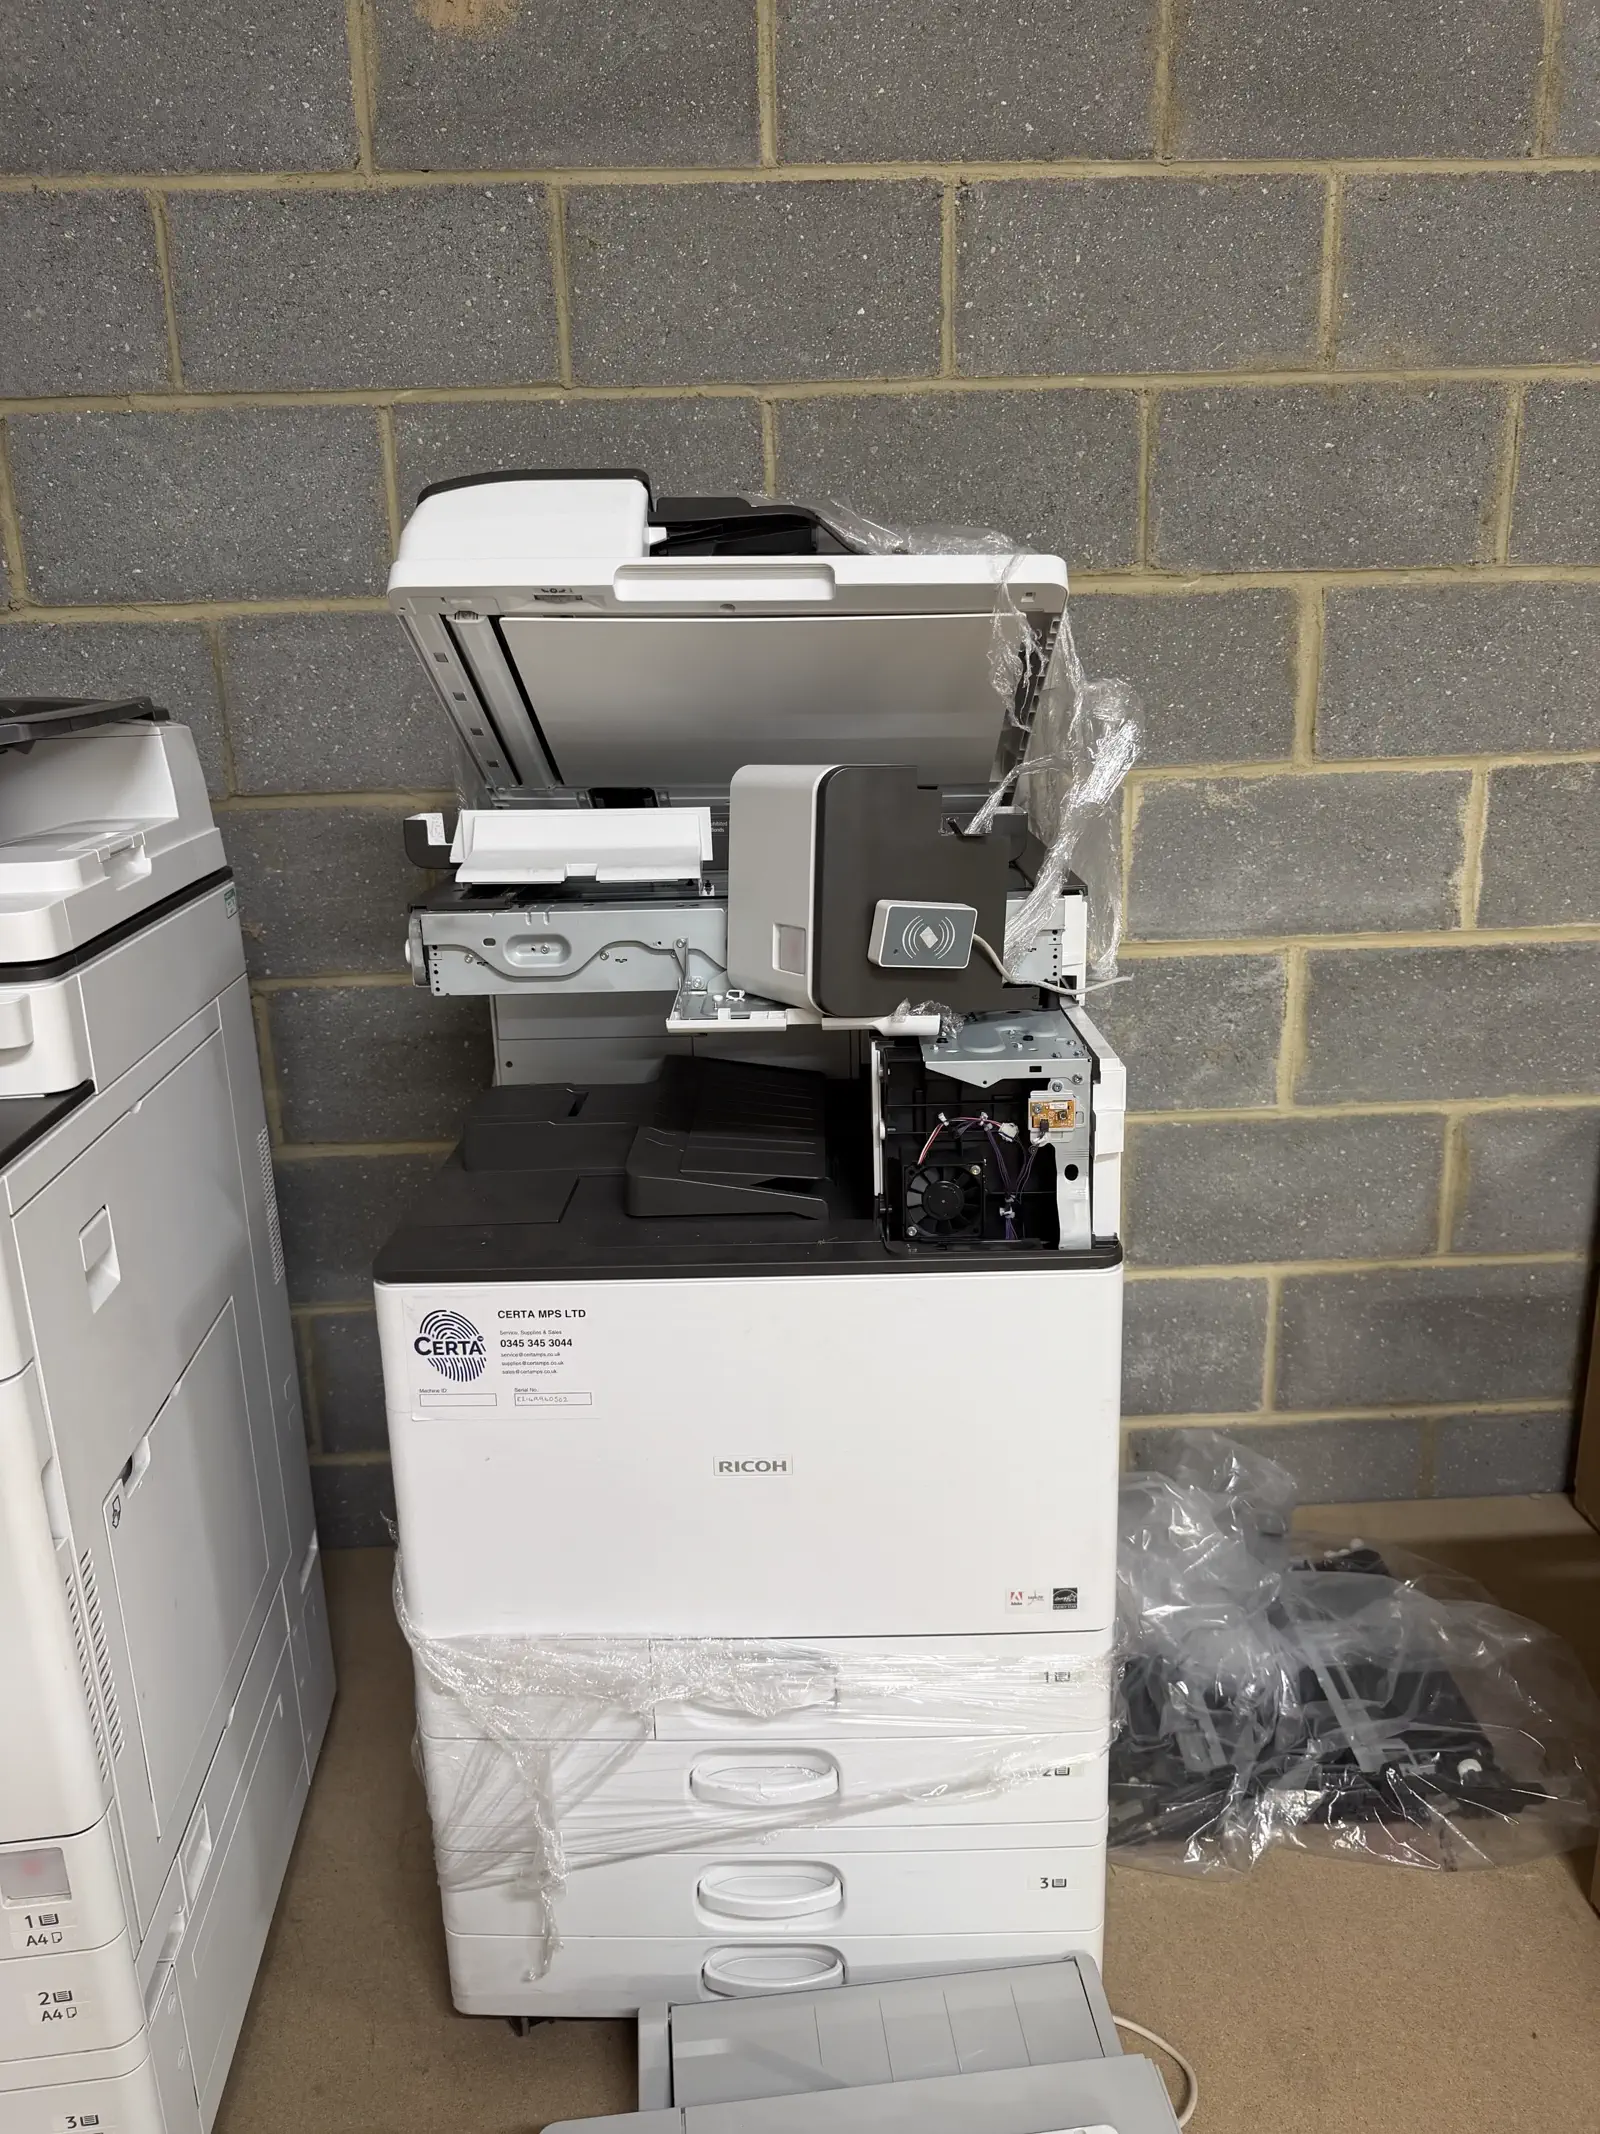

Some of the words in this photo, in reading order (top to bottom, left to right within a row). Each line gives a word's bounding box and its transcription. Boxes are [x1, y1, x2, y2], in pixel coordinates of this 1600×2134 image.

[497, 1310, 535, 1319] CERTA
[538, 1309, 562, 1318] MPS
[565, 1309, 586, 1318] LTD
[414, 1336, 483, 1356] CERTA
[500, 1339, 525, 1348] 0345
[527, 1339, 546, 1348] 345
[548, 1338, 573, 1347] 3044
[718, 1460, 787, 1472] RICOH
[1043, 1671, 1050, 1683] 1
[1040, 1877, 1049, 1889] 3
[25, 1914, 34, 1928] 1
[26, 1932, 49, 1947] A4
[38, 1991, 51, 2006] 2
[41, 2008, 64, 2022] A4
[65, 2115, 78, 2129] 3
